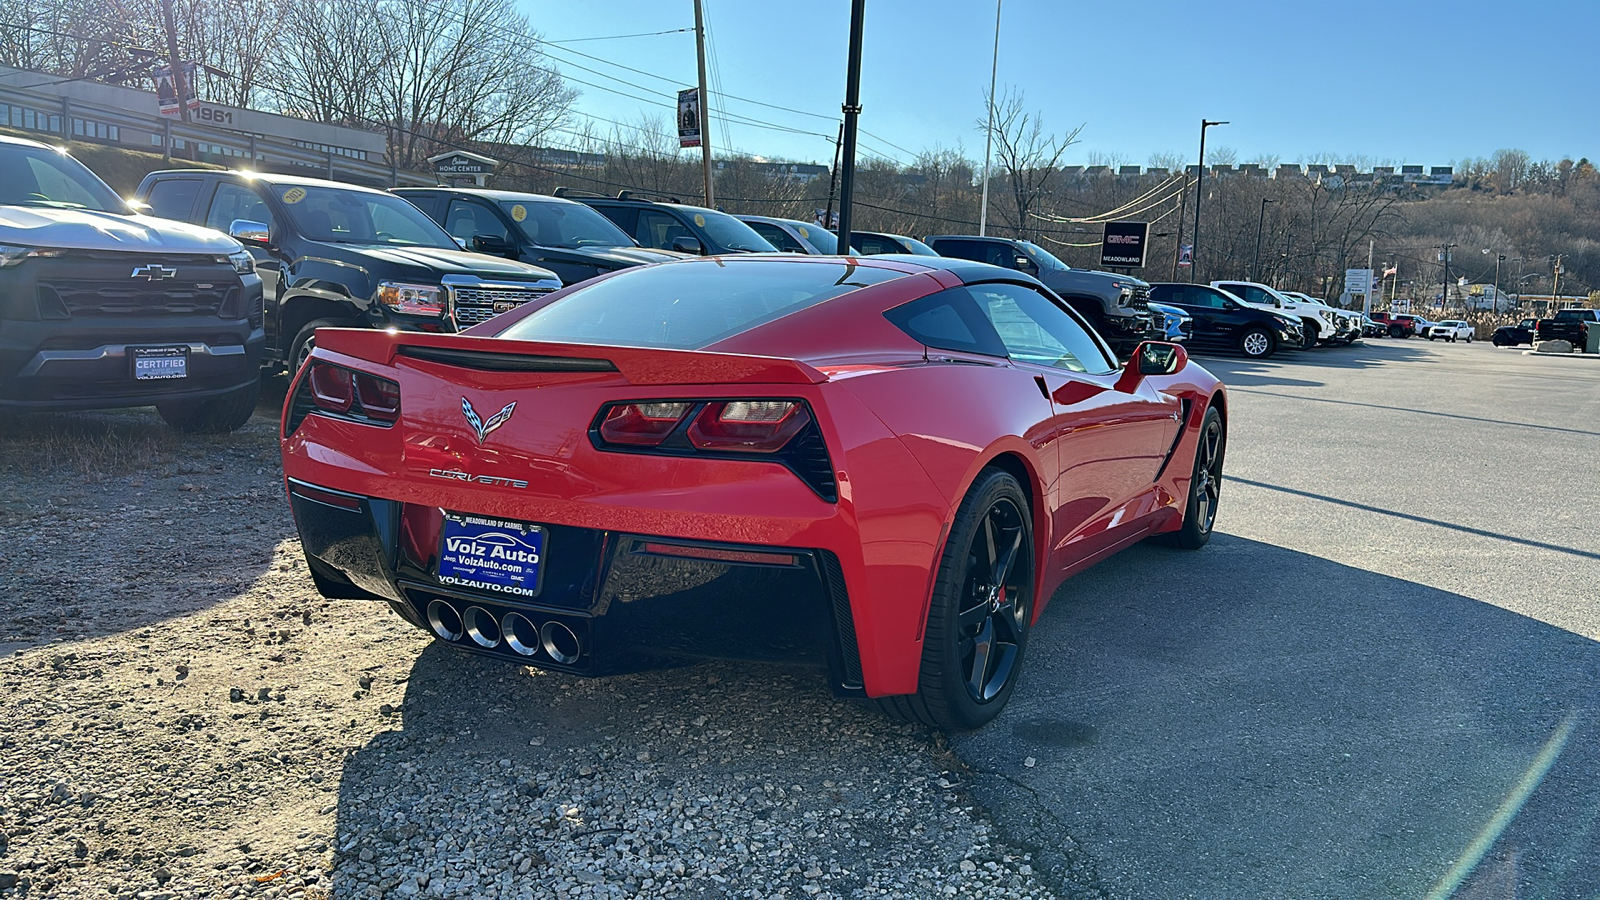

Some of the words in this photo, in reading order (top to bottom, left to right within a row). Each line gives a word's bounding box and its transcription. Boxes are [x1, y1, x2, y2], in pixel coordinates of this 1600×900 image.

[193, 107, 233, 124] 1961
[1107, 235, 1140, 244] GMC
[1102, 255, 1140, 263] MEADOWLAND
[136, 360, 186, 369] CERTIFIED
[429, 468, 529, 489] CORVETTE
[465, 516, 497, 527] MEADOWLAND
[504, 521, 523, 530] CARMEL
[446, 538, 486, 556] Volz
[490, 545, 539, 564] Auto
[458, 554, 522, 573] VolzAuto.com
[438, 575, 533, 597] VOLZAUTO.COM
